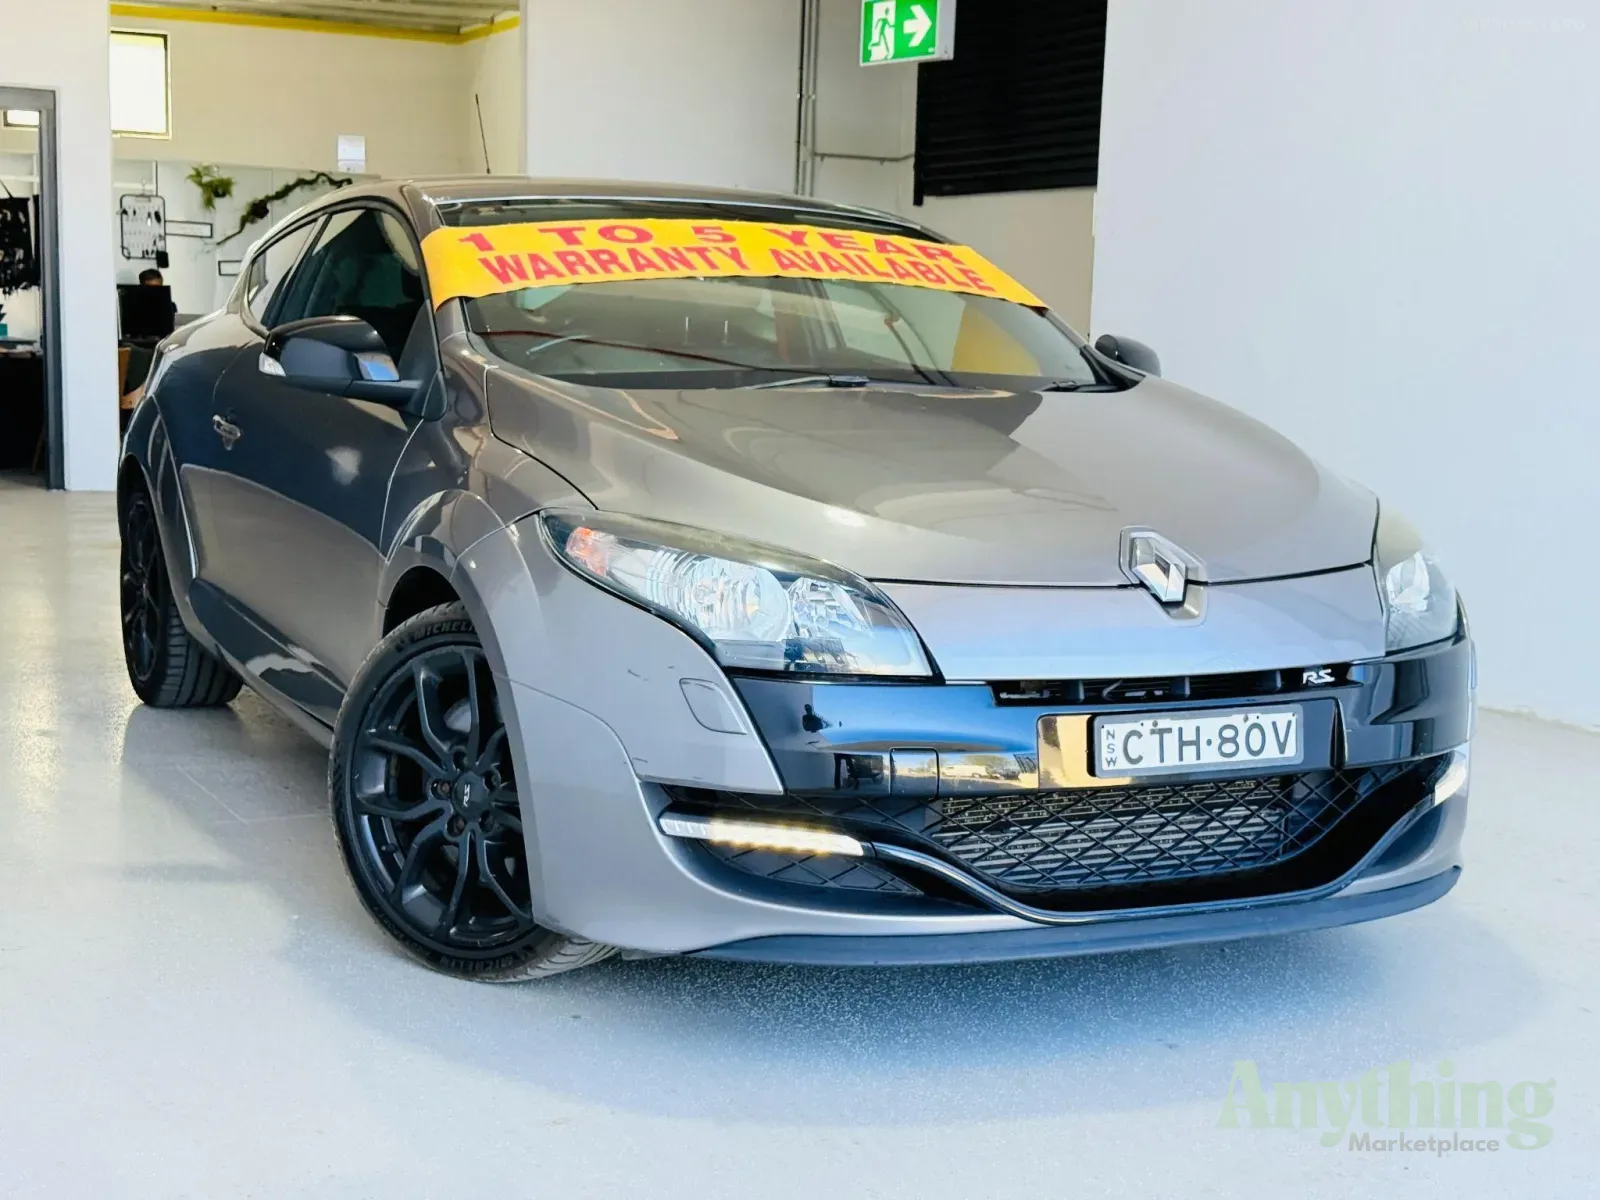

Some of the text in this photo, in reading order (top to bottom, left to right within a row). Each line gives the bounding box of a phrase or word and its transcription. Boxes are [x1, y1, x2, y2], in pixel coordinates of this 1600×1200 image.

[458, 224, 966, 265] 1 TO 5 YEAR
[478, 246, 996, 293] WARRANTY AVAILABLE
[414, 620, 474, 641] MICHELI
[1303, 668, 1335, 685] RS
